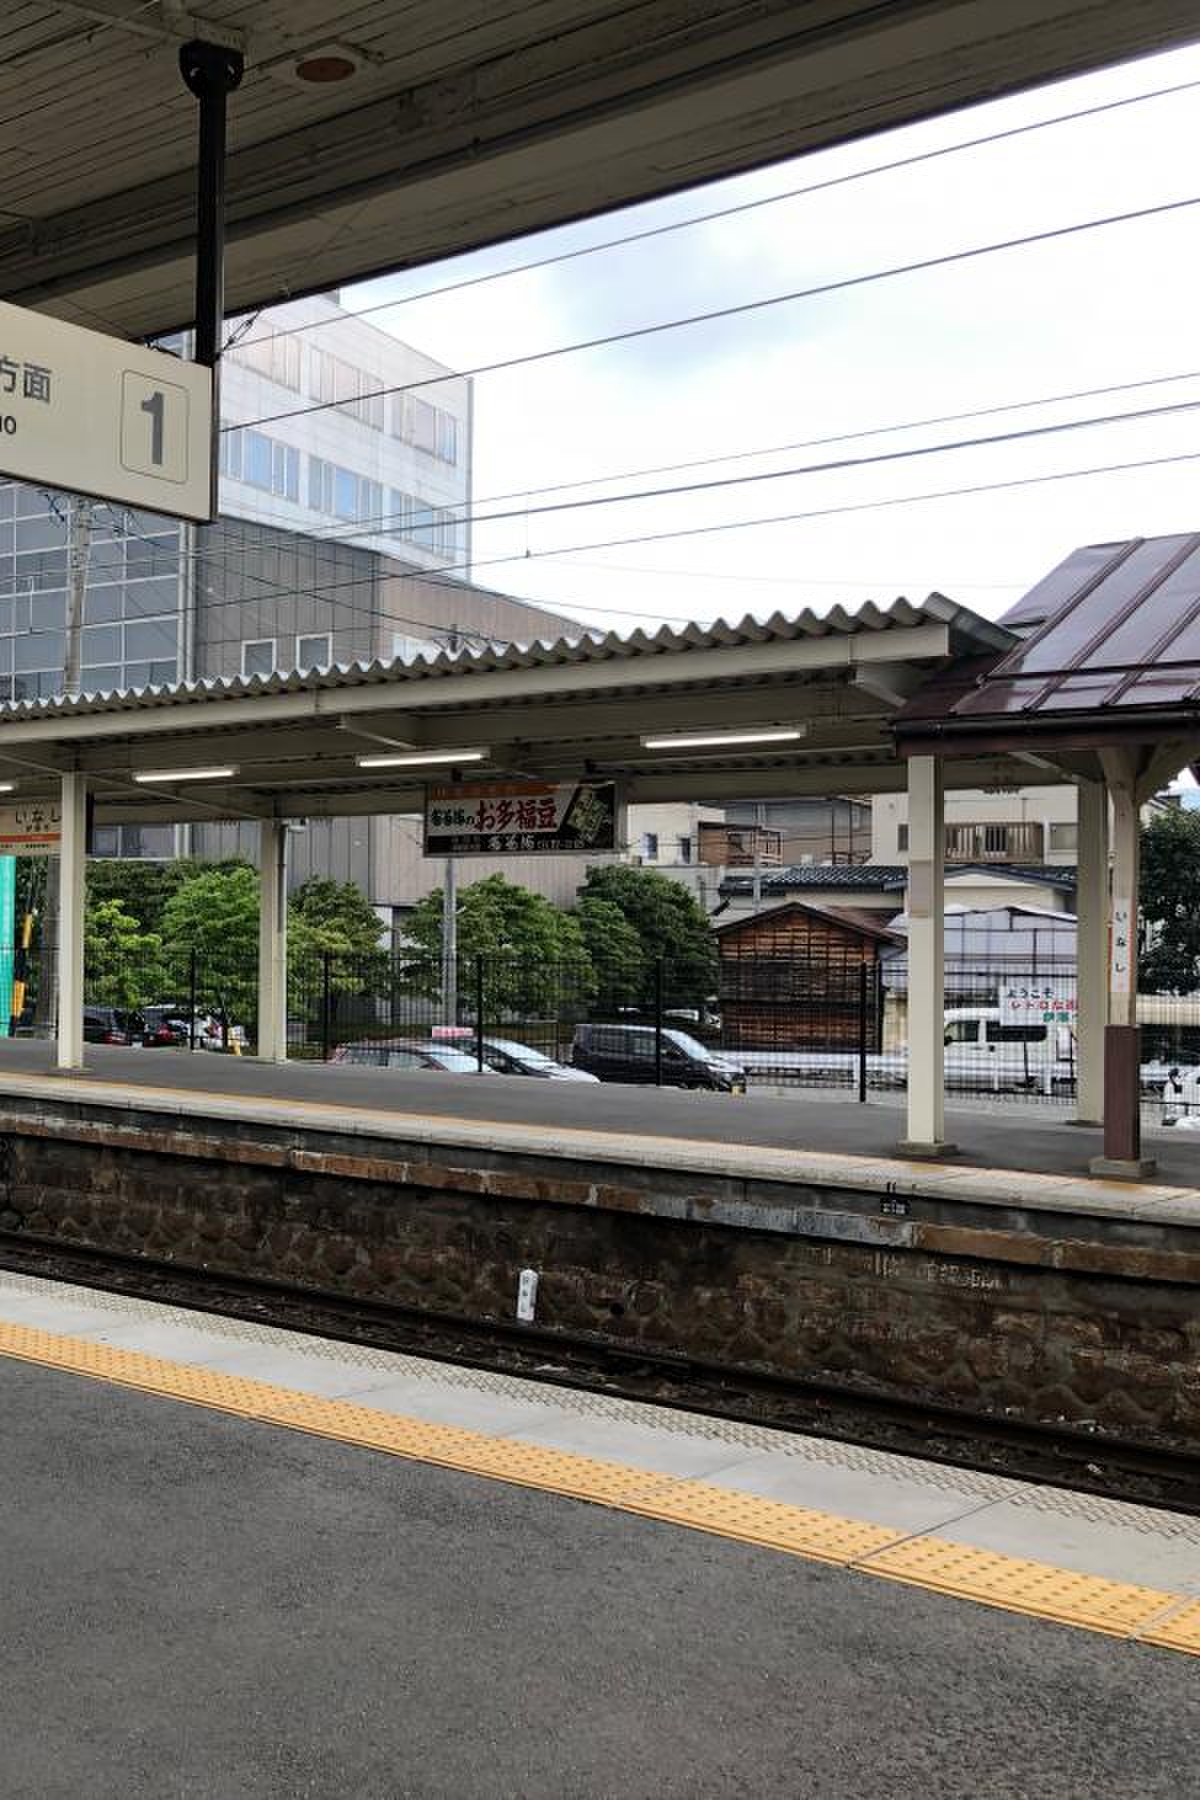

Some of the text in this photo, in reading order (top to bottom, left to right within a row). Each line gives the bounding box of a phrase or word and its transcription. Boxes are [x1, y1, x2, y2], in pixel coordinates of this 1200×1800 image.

[140, 391, 165, 466] 1
[1007, 986, 1055, 999] ようこそ
